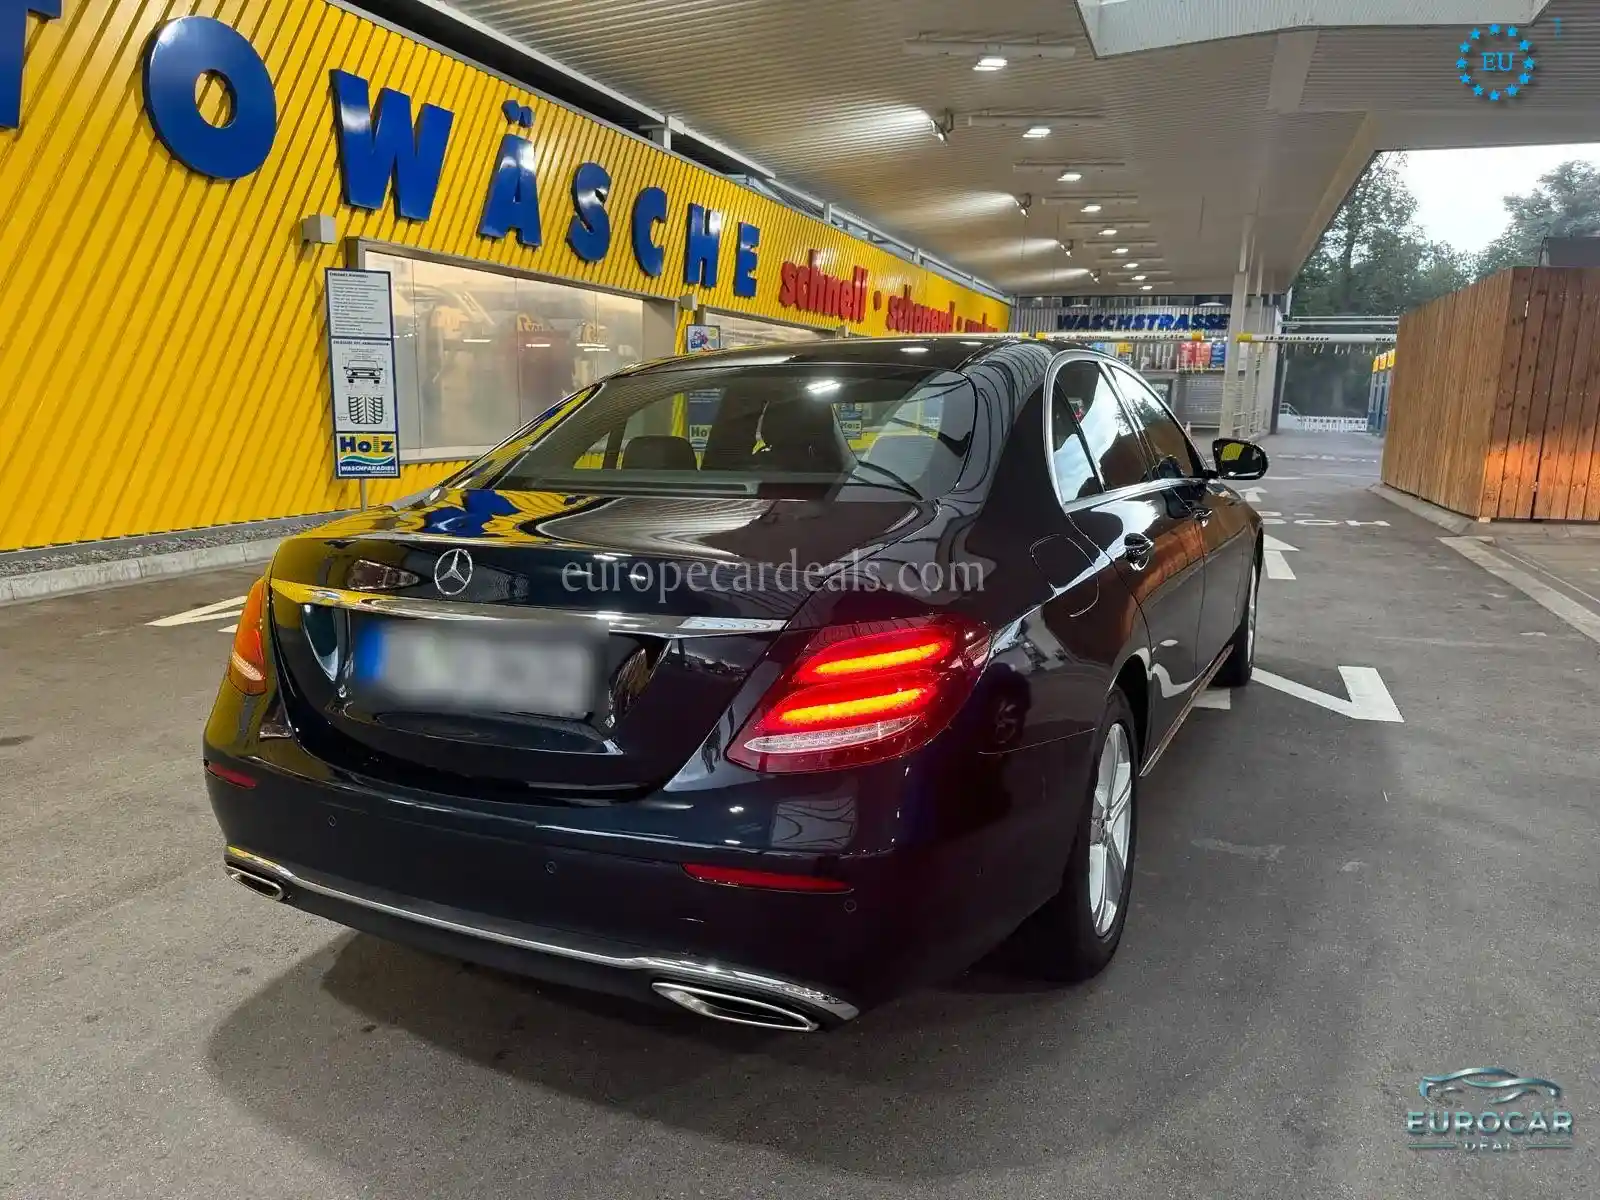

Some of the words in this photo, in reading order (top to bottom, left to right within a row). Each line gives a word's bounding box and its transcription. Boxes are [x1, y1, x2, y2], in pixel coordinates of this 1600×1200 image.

[779, 248, 868, 324] schnell
[1057, 314, 1230, 331] WASCHSTRASSE
[340, 436, 394, 453] Holz
